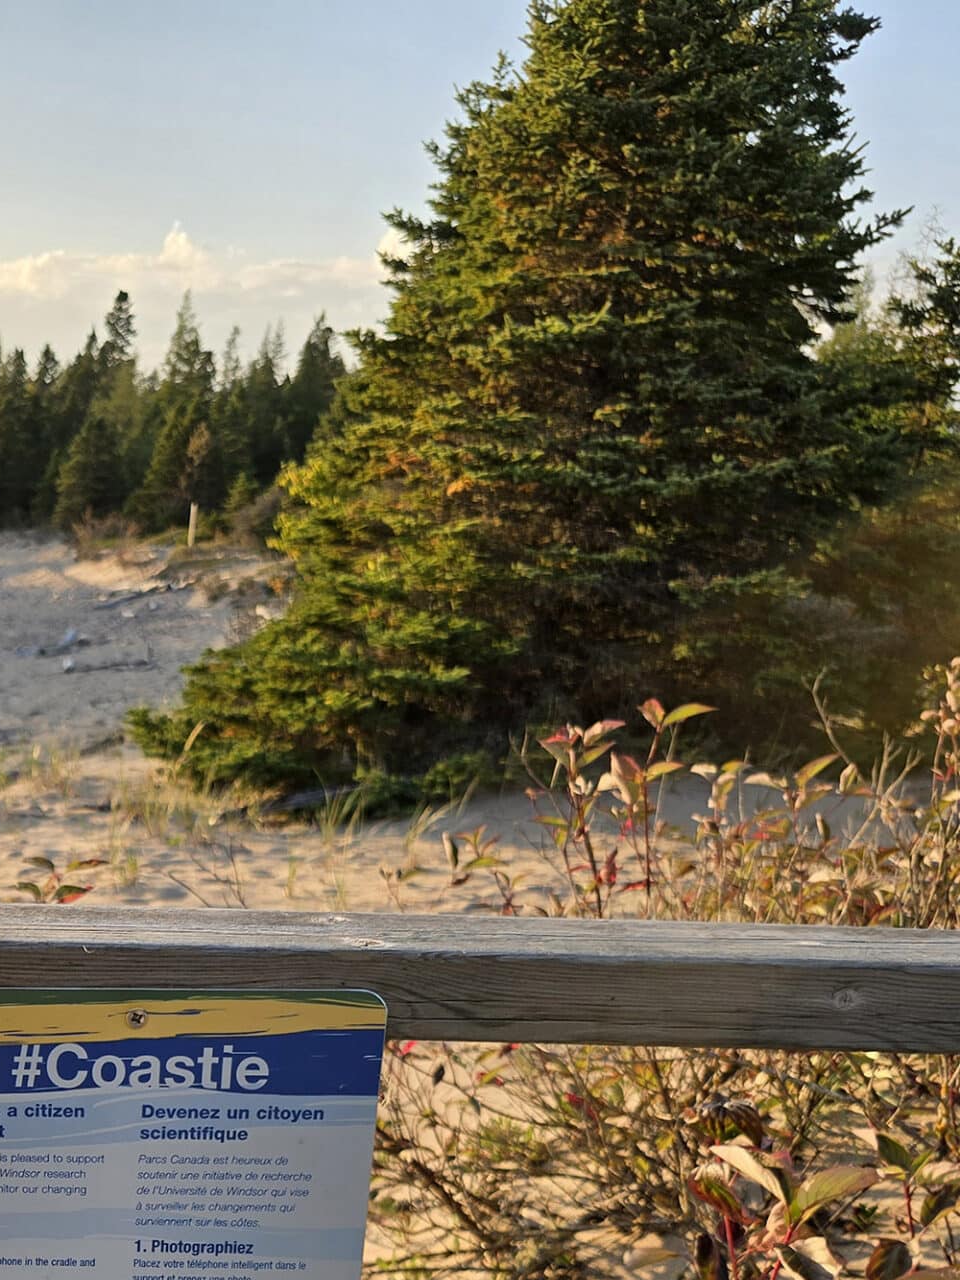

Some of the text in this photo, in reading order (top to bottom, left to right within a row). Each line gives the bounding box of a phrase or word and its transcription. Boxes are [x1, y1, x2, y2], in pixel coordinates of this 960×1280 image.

[11, 1043, 269, 1089] #Coastie
[7, 1106, 17, 1116] a
[25, 1103, 84, 1117] citizen
[141, 1104, 323, 1123] Devenez un citoyen
[140, 1125, 248, 1143] scientifique
[0, 1152, 7, 1161] is
[10, 1152, 49, 1164] pleased
[53, 1153, 63, 1162] to
[66, 1153, 104, 1165] support
[138, 1154, 288, 1164] Parcs Canada est heureux de
[0, 1168, 40, 1177] Windsor
[43, 1168, 86, 1177] research
[137, 1169, 178, 1179] soutenir
[201, 1170, 242, 1179] initiative
[244, 1170, 259, 1180] de
[260, 1171, 312, 1180] recherche
[41, 1184, 86, 1195] changing
[136, 1184, 150, 1194] de
[209, 1185, 223, 1195] de
[226, 1186, 269, 1196] Windsor
[270, 1186, 287, 1198] qui
[289, 1187, 309, 1196] vise
[136, 1201, 296, 1213] à les changements qui
[213, 1217, 227, 1226] les
[134, 1238, 253, 1257] 1. Photographiez
[25, 1256, 32, 1265] in
[35, 1256, 48, 1265] the
[51, 1256, 77, 1266] cradle
[79, 1257, 95, 1266] and
[133, 1258, 306, 1271] Placez votre téléphone intelligent dans le
